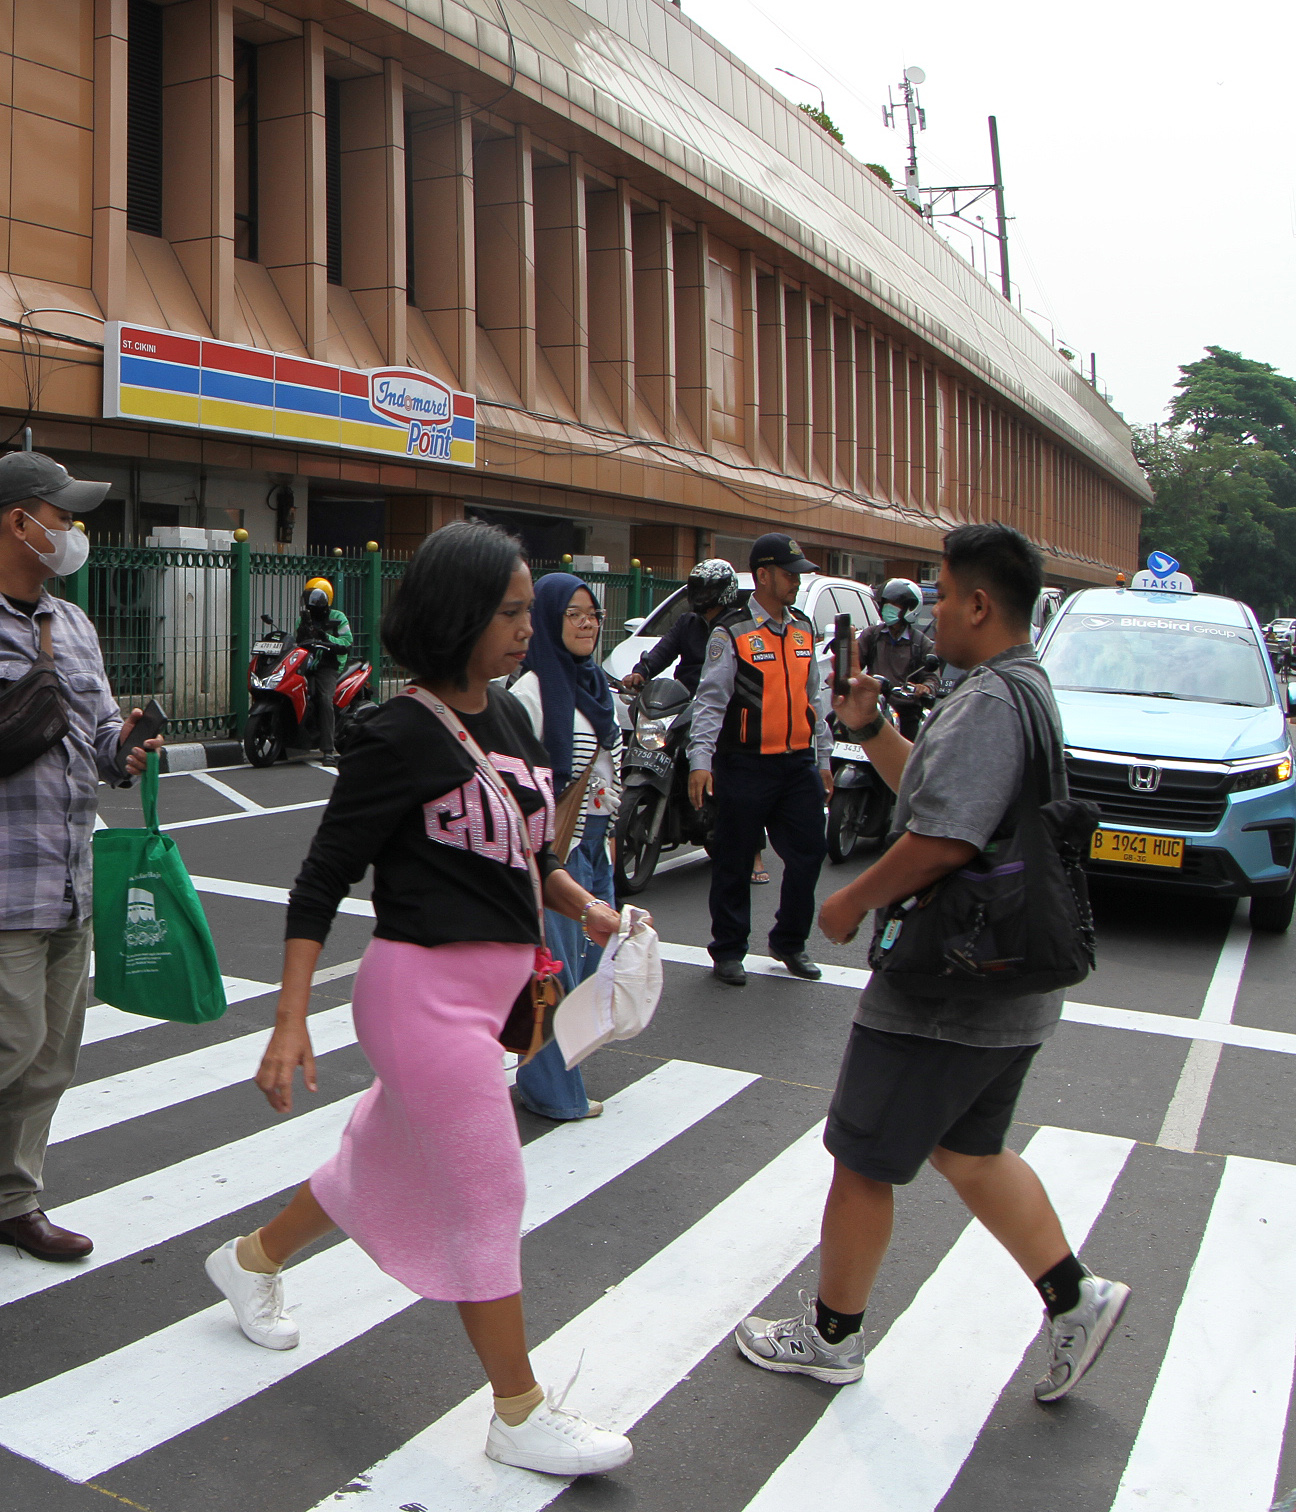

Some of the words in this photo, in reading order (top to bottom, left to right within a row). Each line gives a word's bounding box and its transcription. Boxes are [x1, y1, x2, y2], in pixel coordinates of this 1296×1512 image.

[123, 340, 133, 349] ST.
[134, 341, 156, 353] CIKINI
[376, 381, 447, 416] Indomaret
[407, 421, 452, 458] Point
[1142, 579, 1182, 590] TAKSI
[1120, 618, 1190, 632] Bluebird
[1193, 625, 1236, 639] Group
[656, 752, 669, 765] TNF
[1094, 832, 1103, 849] B
[1112, 834, 1147, 854] 1941
[1153, 838, 1180, 858] HUC
[789, 1340, 806, 1355] N
